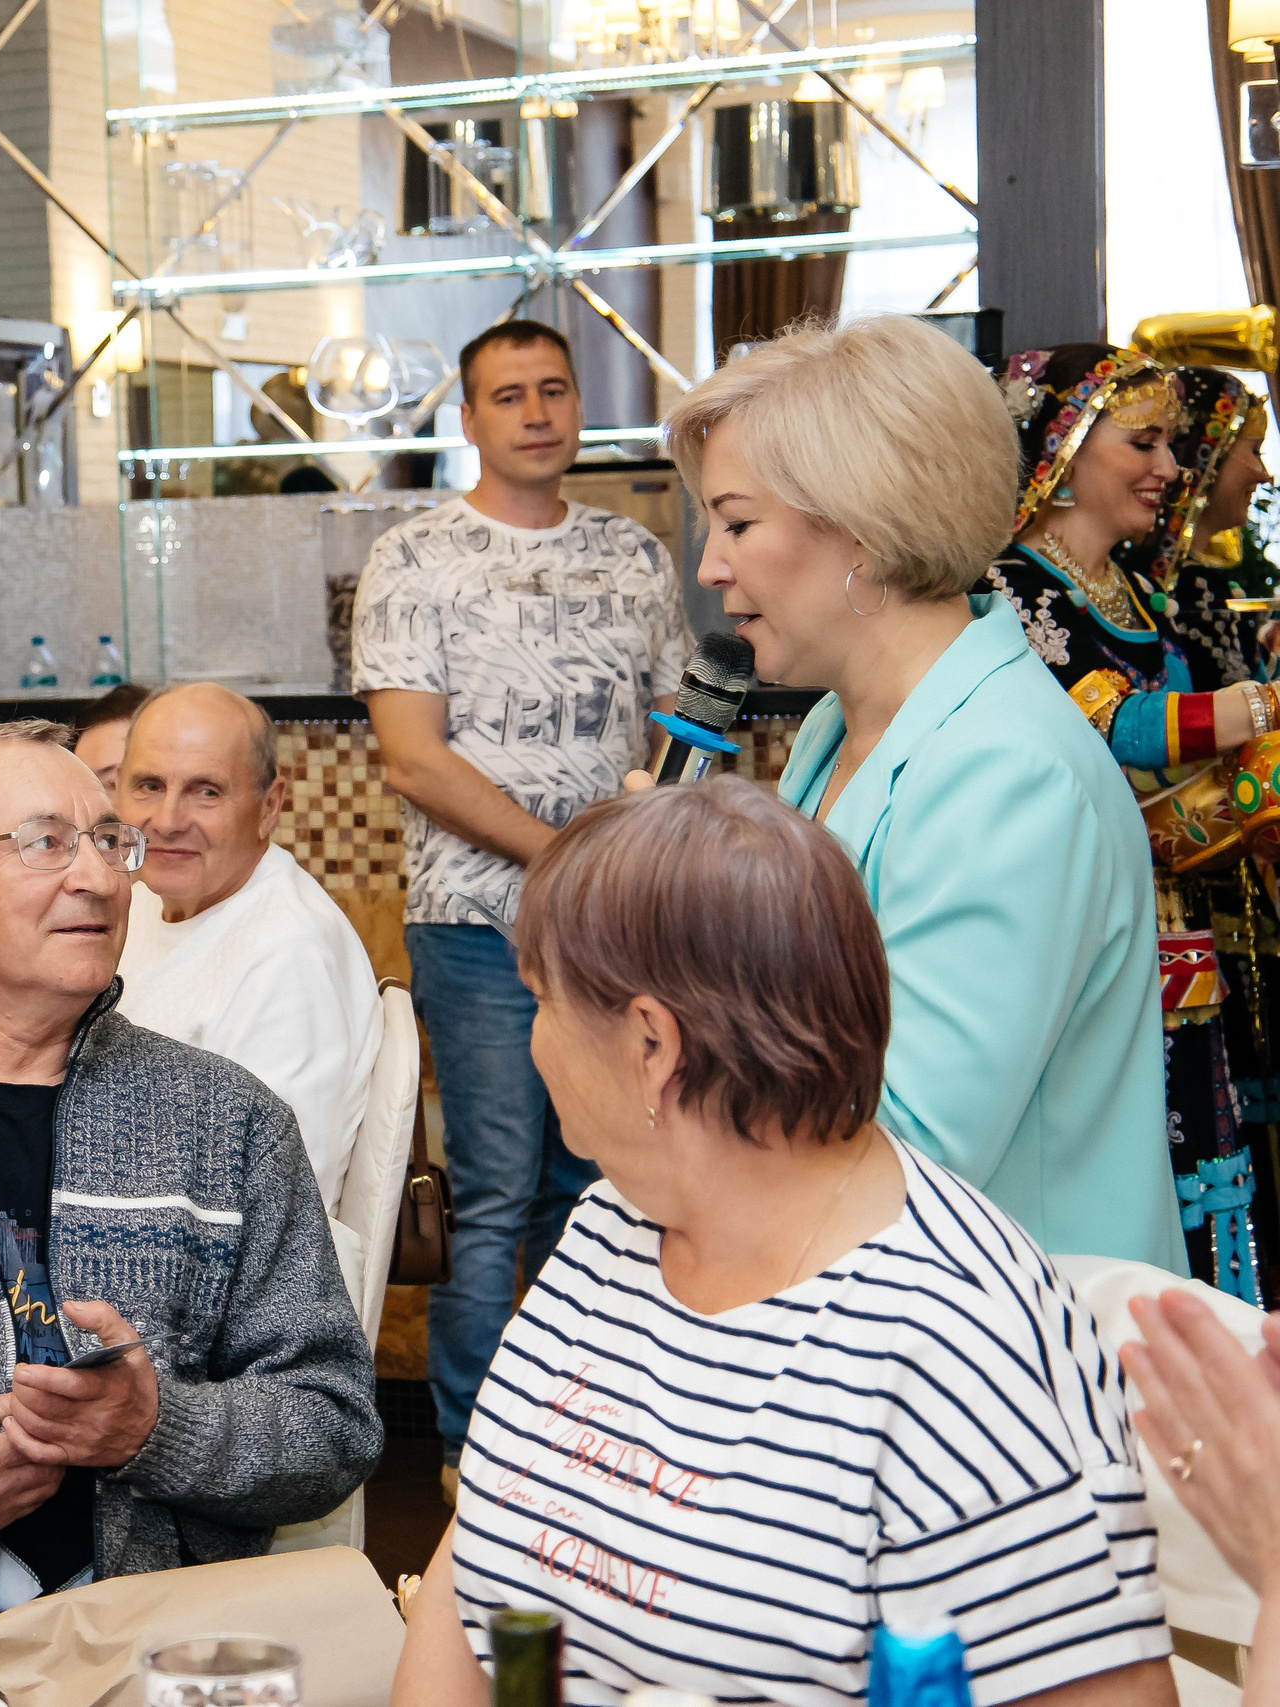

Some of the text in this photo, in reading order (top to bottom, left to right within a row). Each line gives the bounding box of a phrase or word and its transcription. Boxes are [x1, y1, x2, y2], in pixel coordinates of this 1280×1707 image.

[551, 1400, 624, 1450] you
[496, 1459, 539, 1508] You
[522, 1528, 680, 1619] ACHIEVE
